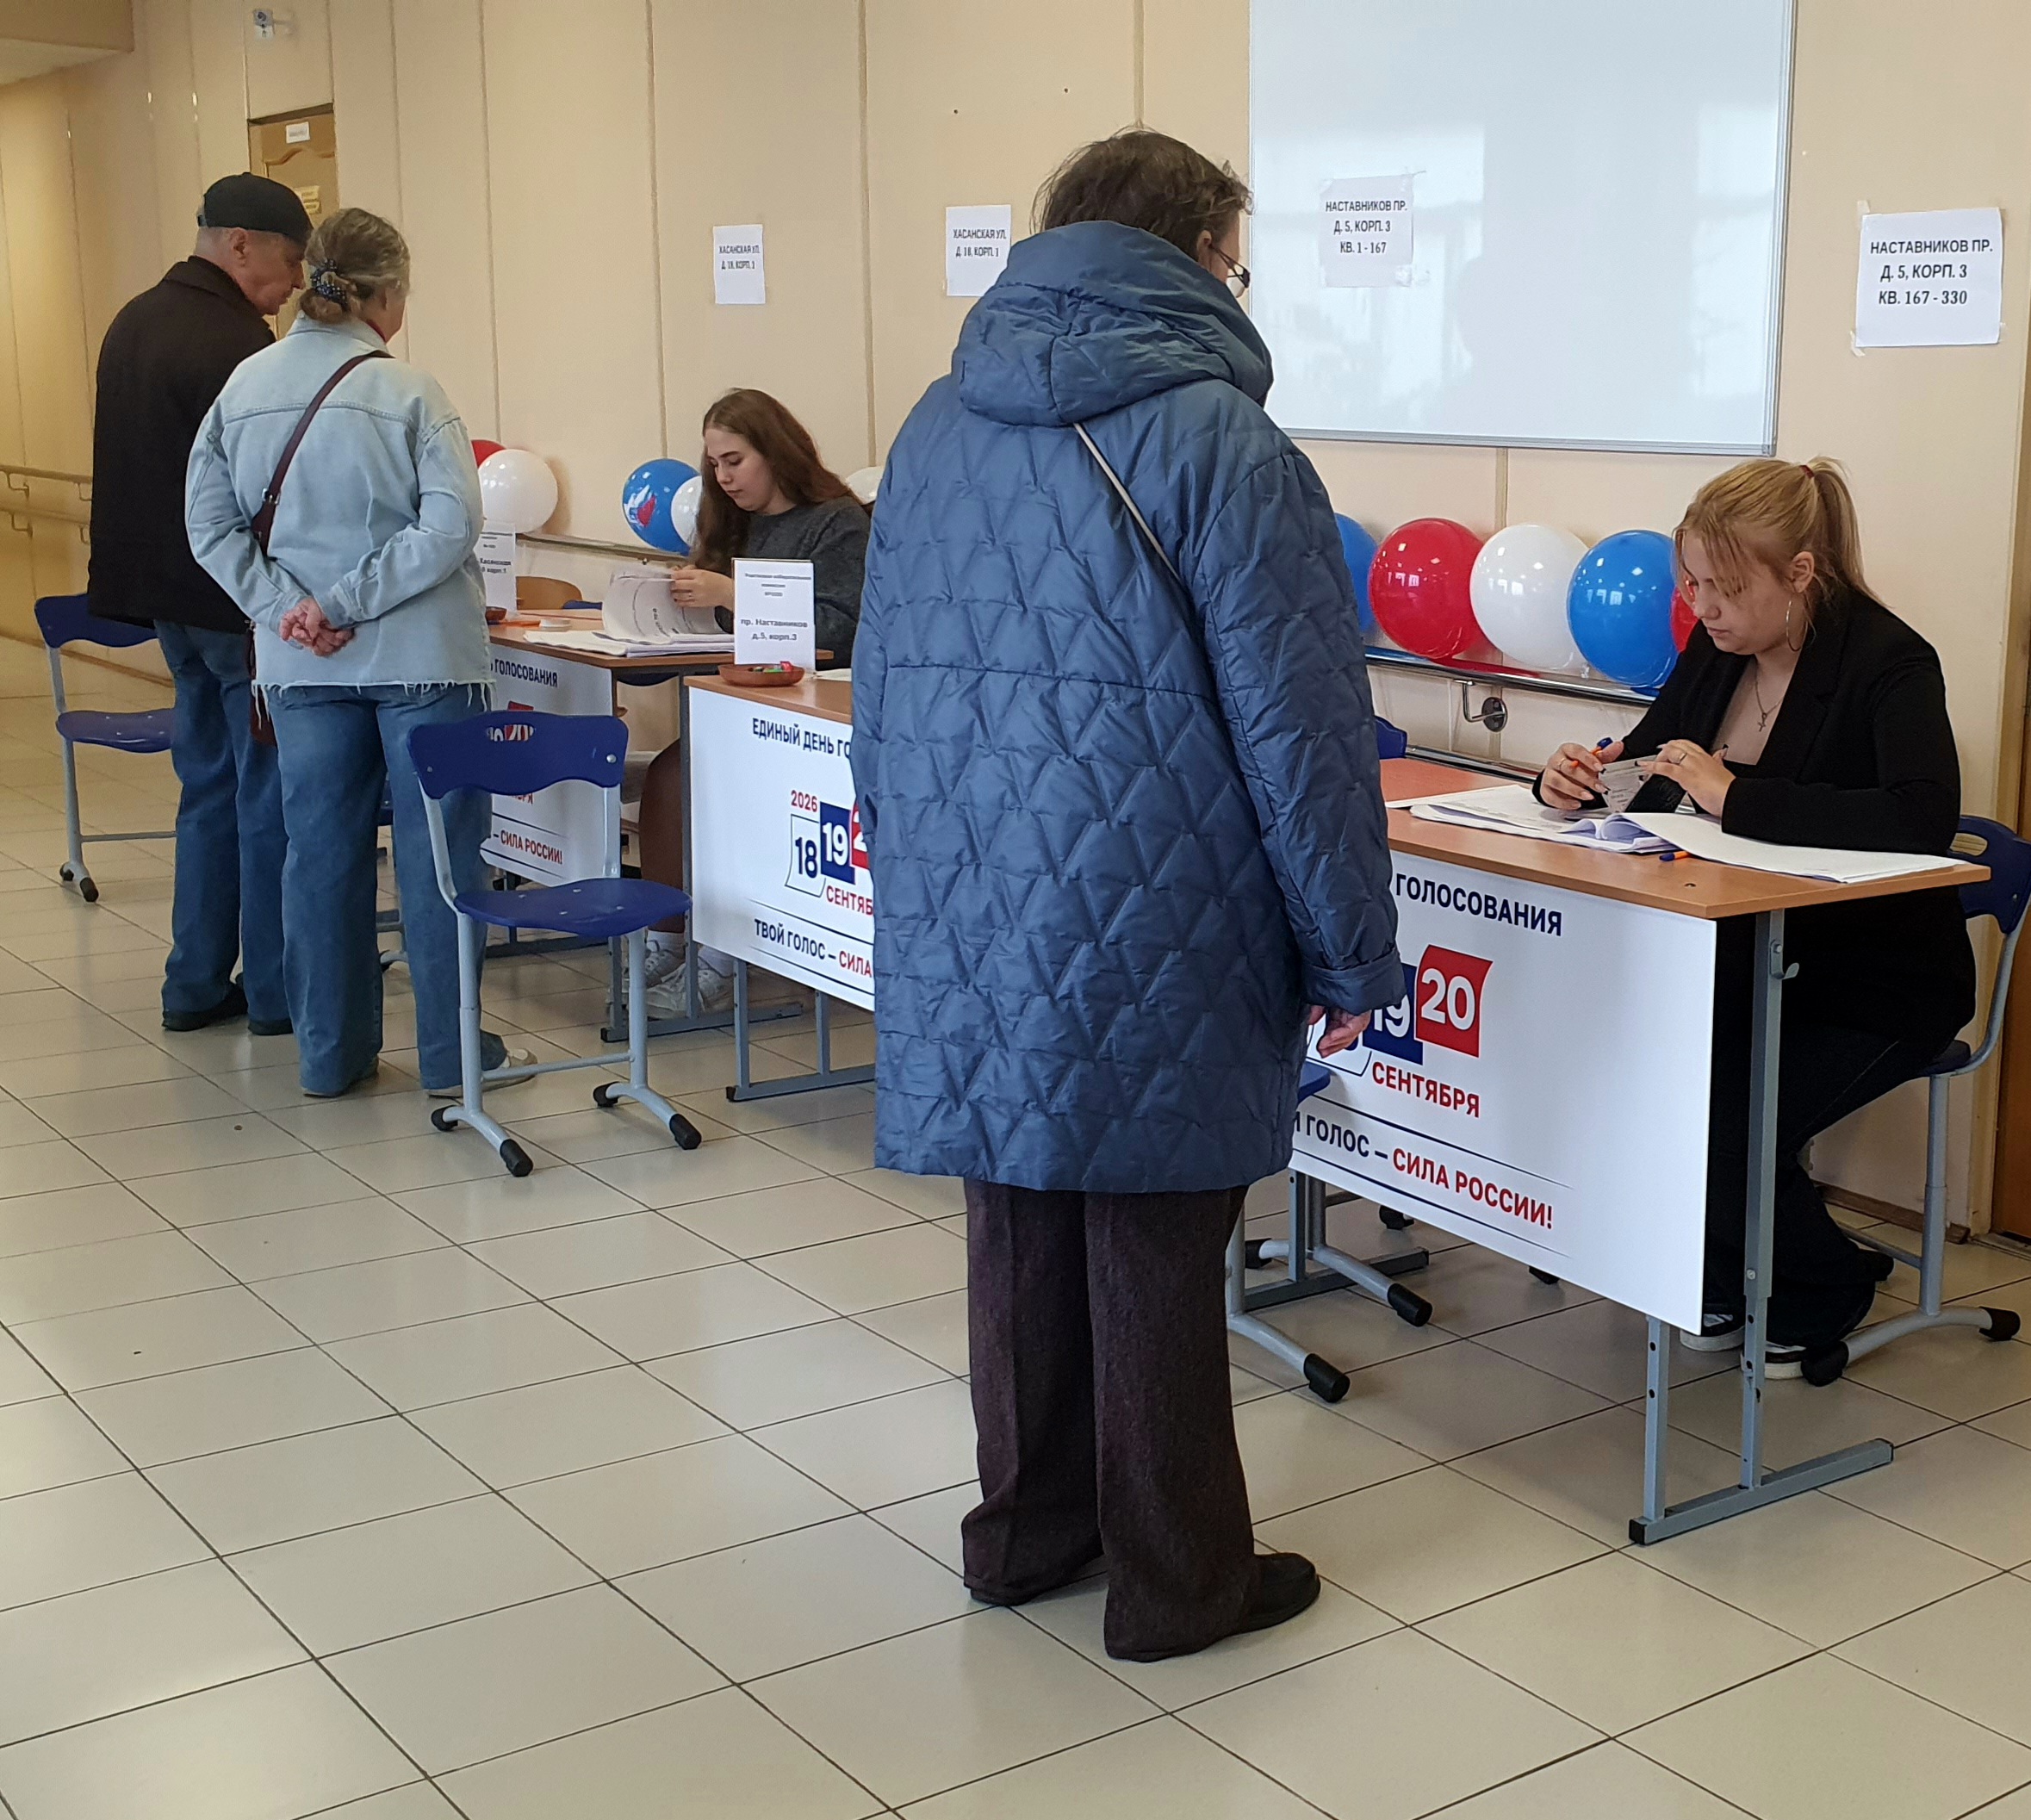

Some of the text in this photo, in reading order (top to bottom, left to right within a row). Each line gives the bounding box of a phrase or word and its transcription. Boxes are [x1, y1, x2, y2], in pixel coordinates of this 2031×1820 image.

[1326, 200, 1407, 212] НАСТАВНИКОВ ПР.
[953, 228, 995, 239] ХАСАНСКАЯ
[1333, 220, 1391, 235] Д. 5, КОРП. 3
[1339, 241, 1355, 253] КВ.
[1357, 242, 1363, 253] 1
[1370, 242, 1387, 253] 167
[1870, 239, 1993, 254] НАСТАВНИКОВ ПР.
[1880, 264, 1967, 283] Д. 5, КОРП. 3
[1879, 291, 1901, 305] КВ.
[1904, 291, 1930, 305] 167
[1941, 290, 1967, 305] 330
[494, 659, 558, 687] ГОЛОСОВАНИЯ
[752, 717, 801, 747] ЕДИНЫЙ
[803, 730, 834, 755] ДЕНЬ
[791, 790, 818, 813] 2026
[500, 829, 524, 850] СИЛА
[525, 838, 562, 865] РОССИИ!
[795, 836, 817, 879] 18
[822, 822, 849, 867] 19
[826, 885, 873, 916] СЕНТЯБ
[1395, 873, 1562, 936] ГОЛОСОВАНИЯ
[754, 918, 785, 945] ТВОЙ
[787, 931, 826, 960] ГОЛОС
[839, 950, 873, 978] СИЛА
[1421, 967, 1476, 1030] 20
[1372, 1061, 1480, 1118] СЕНТЯБРЯ
[1306, 1115, 1370, 1158] ГОЛОС
[1393, 1147, 1450, 1190] СИЛА
[1456, 1170, 1553, 1230] РОССИИ!
